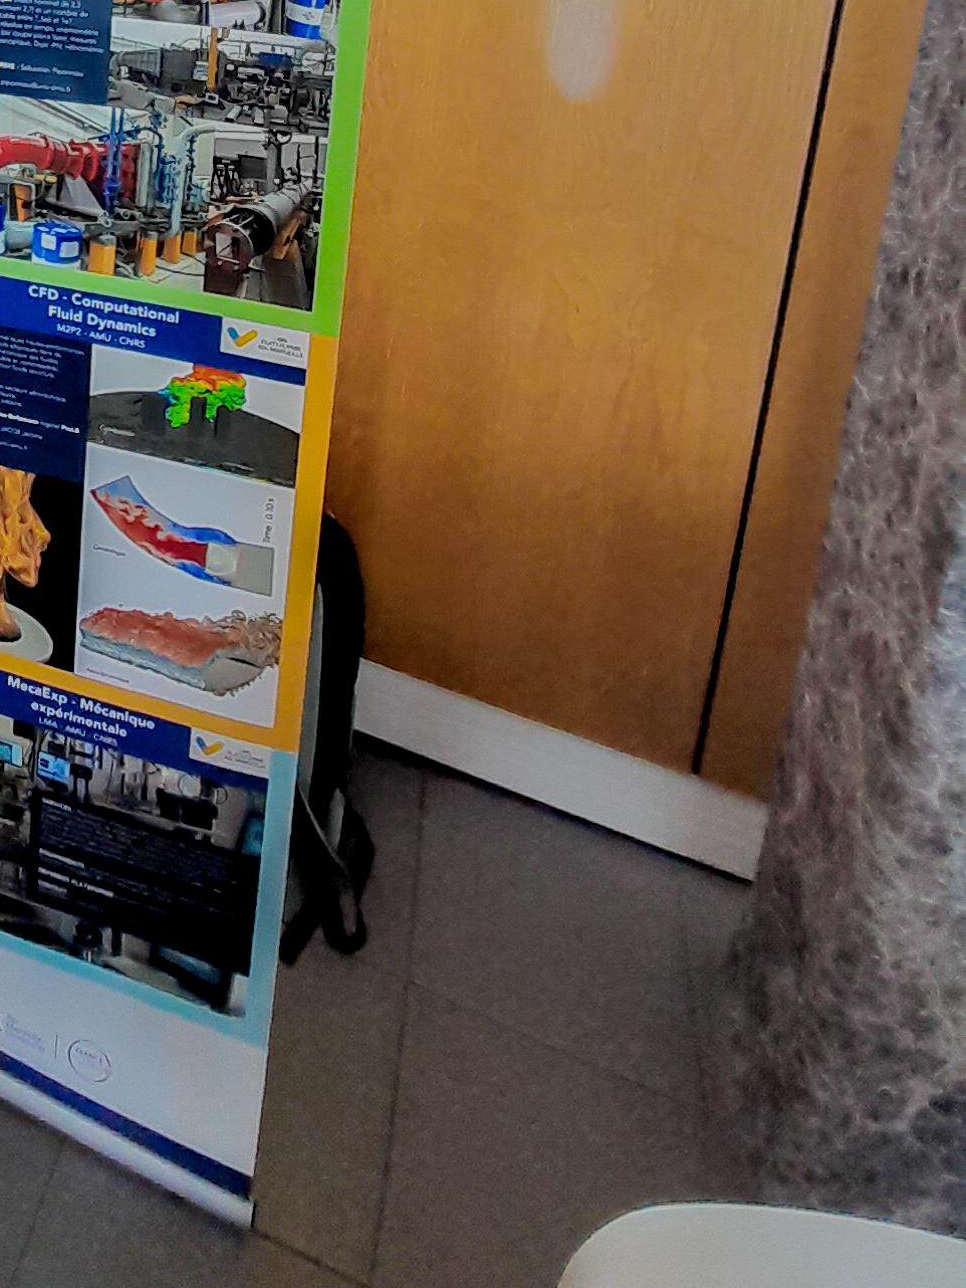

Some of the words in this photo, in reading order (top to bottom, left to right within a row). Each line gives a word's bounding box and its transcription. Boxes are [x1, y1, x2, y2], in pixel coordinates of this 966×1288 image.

[27, 284, 60, 301] CFD
[71, 293, 180, 324] Computational
[48, 304, 83, 323] Fluid
[86, 312, 157, 337] Dynamics
[56, 323, 82, 337] M2P2
[89, 331, 112, 343] AMU
[118, 336, 146, 349] CNRS
[7, 675, 68, 706] MecaExp
[79, 698, 156, 730] Mécanique
[30, 701, 128, 738] expérimentale
